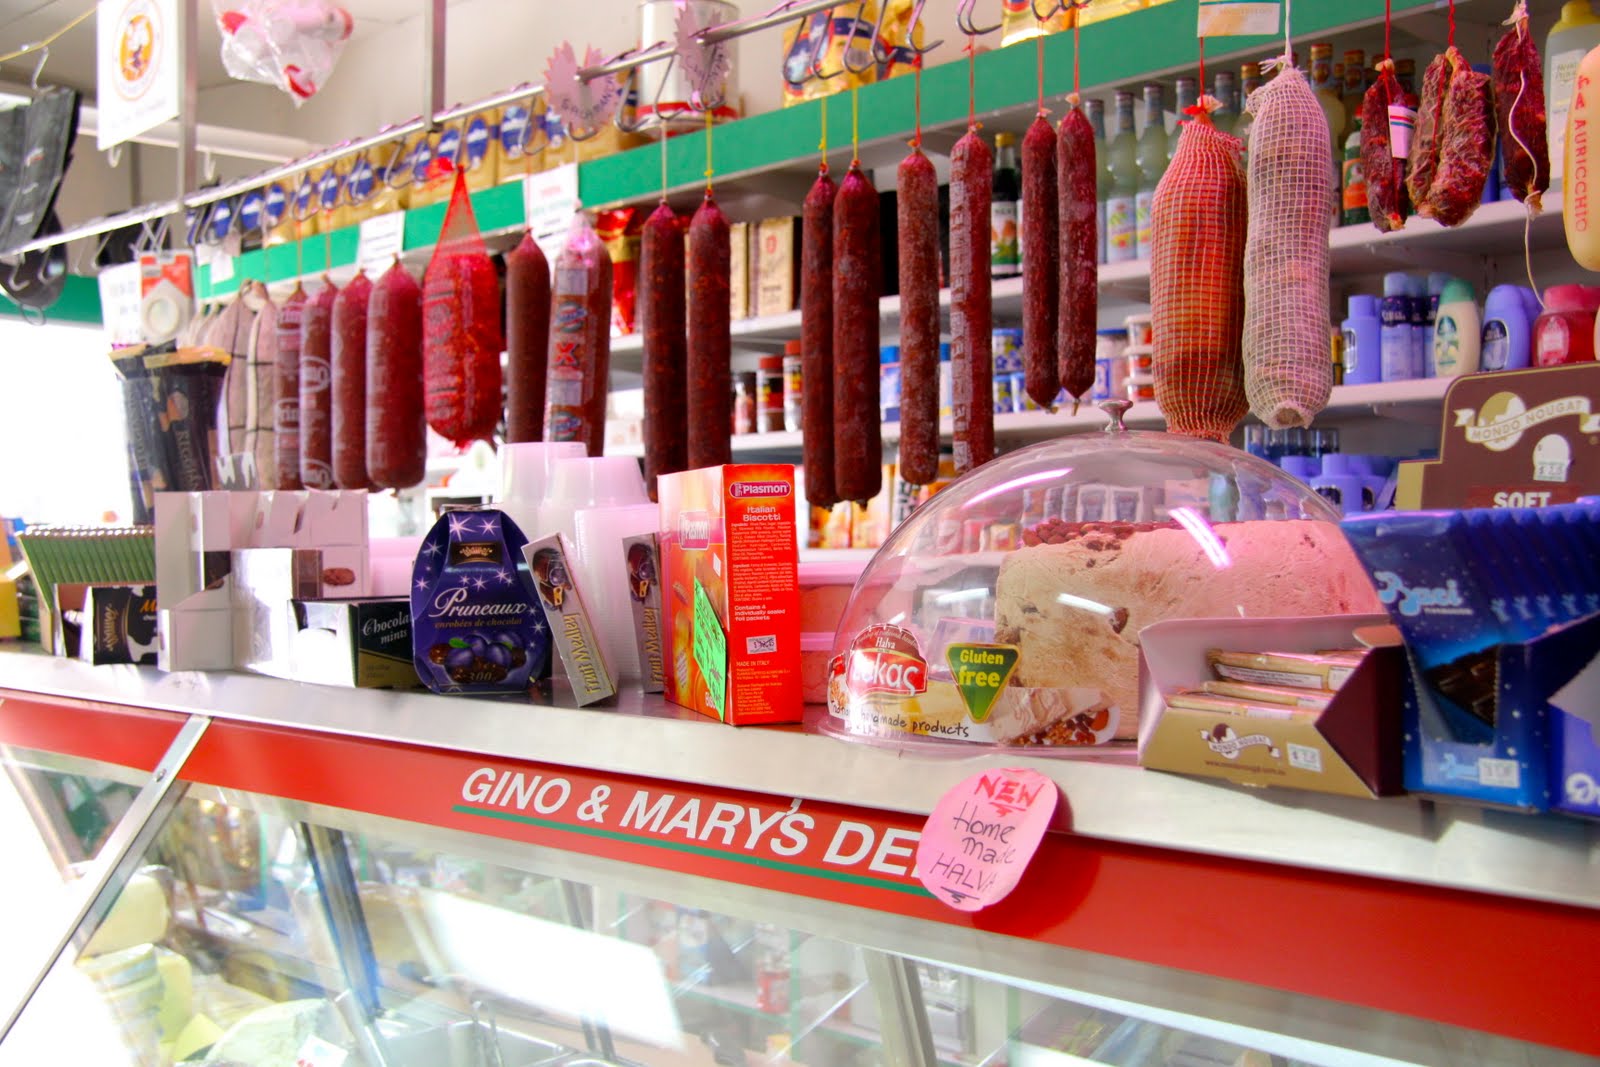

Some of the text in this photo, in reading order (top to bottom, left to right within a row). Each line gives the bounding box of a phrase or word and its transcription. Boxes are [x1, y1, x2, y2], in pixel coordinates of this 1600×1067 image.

[1574, 119, 1588, 233] AURICCHIO
[1471, 400, 1585, 440] MONDO NOUGAT
[743, 484, 787, 494] Plasmon
[1492, 491, 1552, 509] SOFT
[743, 513, 781, 522] Biscotti
[747, 506, 776, 514] Italian
[428, 586, 528, 618] Pruneaux
[362, 610, 410, 637] Chocola
[474, 618, 486, 627] de
[486, 617, 523, 626] chocolat
[380, 629, 408, 645] mints
[641, 606, 664, 685] Fruit Medley
[875, 636, 897, 650] Halva
[563, 612, 602, 695] Fruit Medley
[960, 649, 1004, 665] Gluten
[958, 665, 1001, 688] free
[912, 719, 970, 738] products
[974, 774, 1045, 808] NEW
[461, 767, 572, 815] GINO
[576, 784, 612, 823] &
[619, 790, 816, 857] MARY'S
[953, 801, 1016, 844] Home
